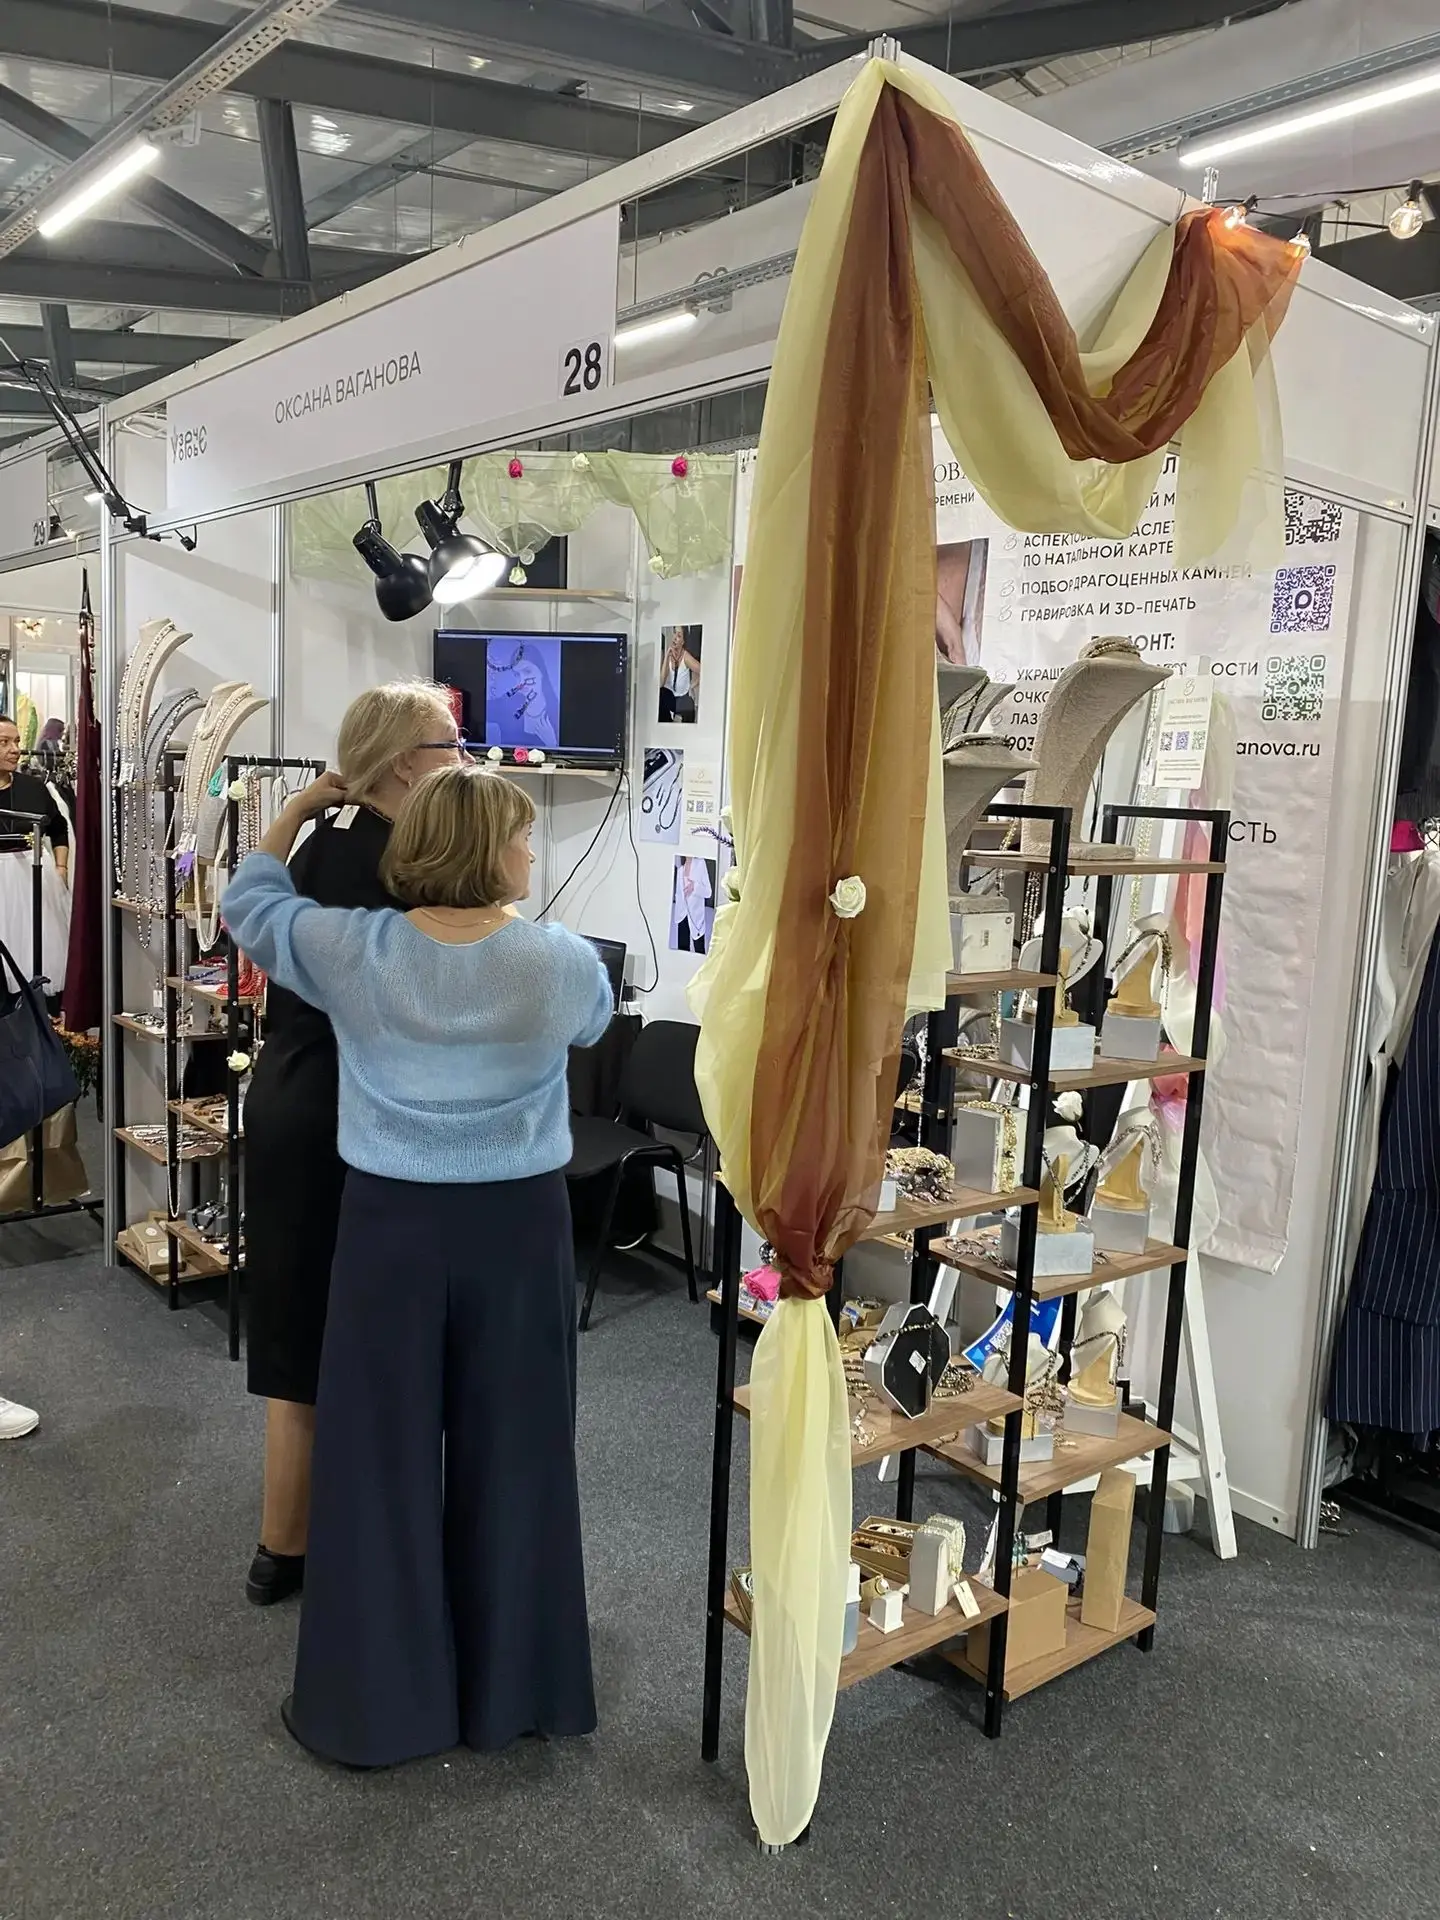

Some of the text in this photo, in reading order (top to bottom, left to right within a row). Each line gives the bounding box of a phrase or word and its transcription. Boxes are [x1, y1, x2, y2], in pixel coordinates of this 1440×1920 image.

[563, 342, 601, 396] 28
[275, 351, 421, 423] ОКСАНА ВАГАНОВА
[33, 520, 45, 546] 29
[1023, 540, 1174, 567] ПО НАТАЛЬНОЙ КАРТЕ
[1021, 596, 1196, 621] ГРАВИРОВКА И 3D-ПЕЧАТЬ
[1017, 667, 1065, 681] УКРАШ
[1236, 741, 1321, 756] anova.ru
[1228, 820, 1277, 843] СТЬ
